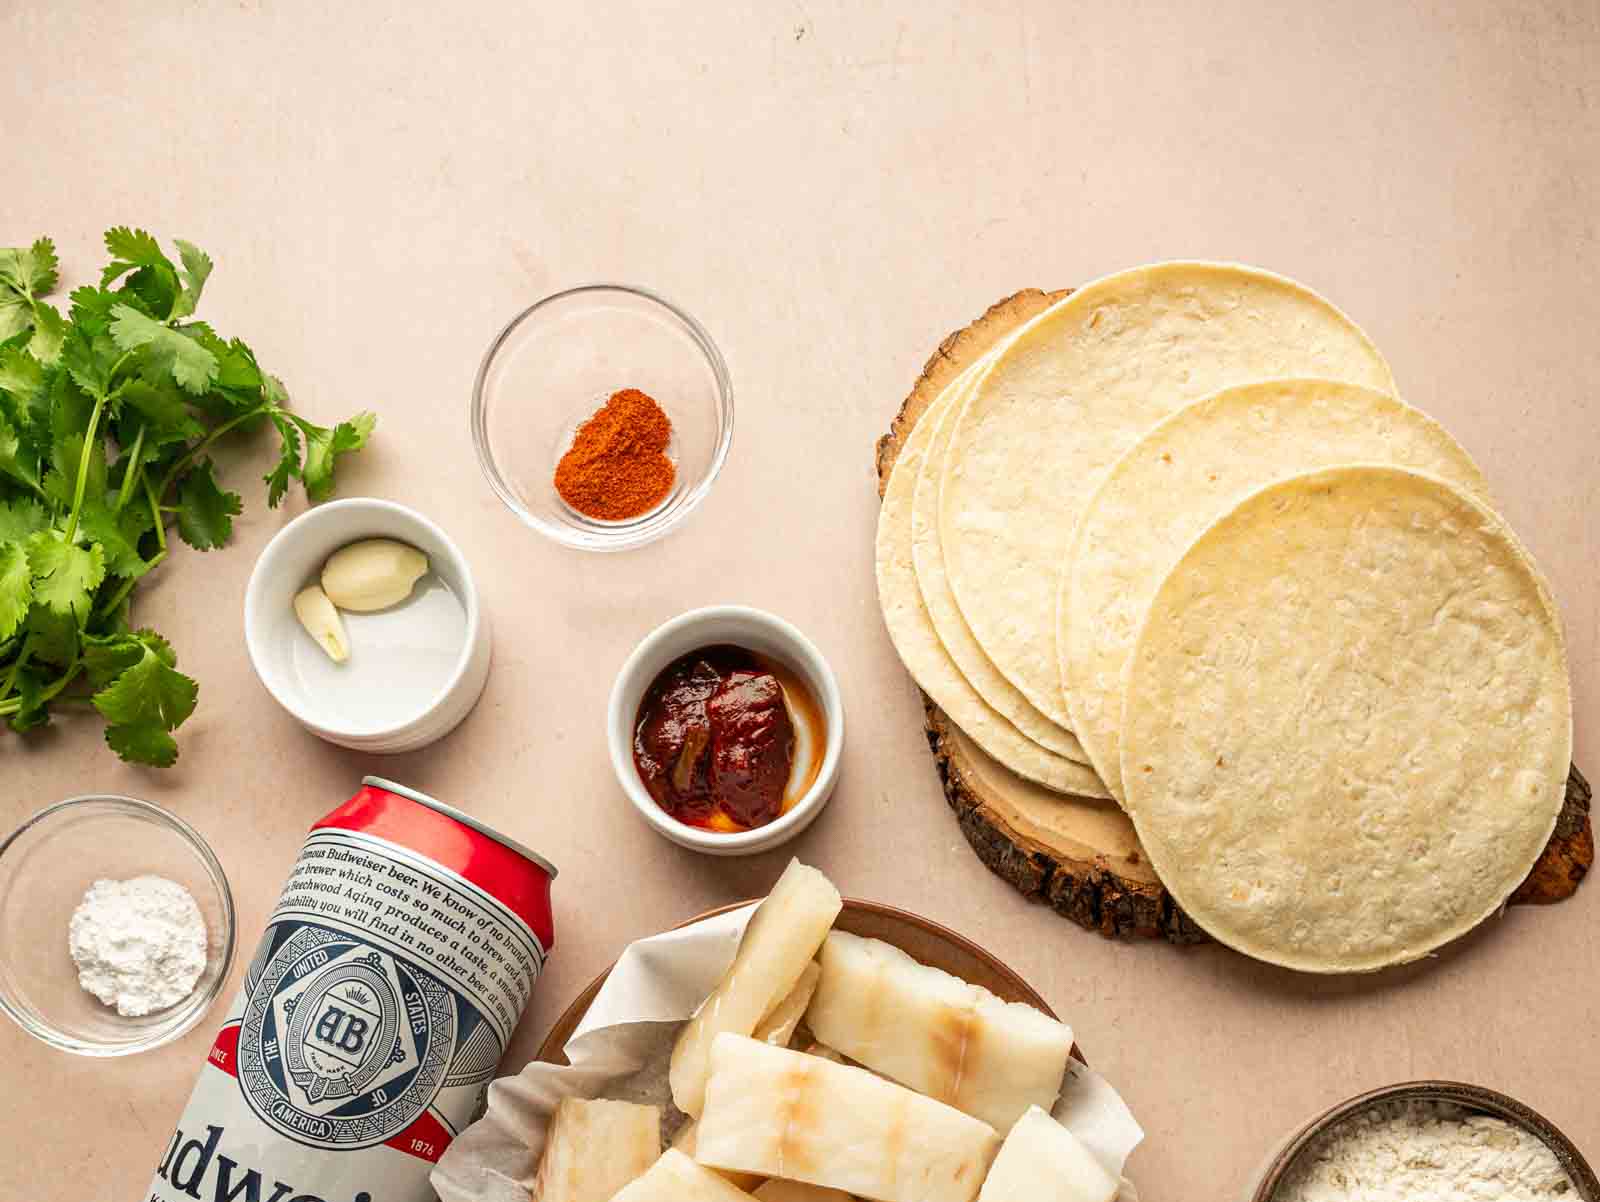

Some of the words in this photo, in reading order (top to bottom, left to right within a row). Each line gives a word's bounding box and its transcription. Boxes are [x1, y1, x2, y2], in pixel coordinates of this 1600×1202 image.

[305, 863, 336, 877] brewer
[338, 868, 372, 887] which
[376, 881, 410, 902] costs
[412, 899, 429, 912] so
[431, 908, 466, 935] much
[467, 930, 481, 944] to
[480, 940, 505, 964] brew
[504, 961, 520, 981] and
[327, 848, 387, 873] Budweiser
[387, 865, 418, 889] beer.
[421, 881, 441, 899] We
[442, 893, 478, 919] know
[476, 917, 494, 930] of
[489, 926, 504, 941] no
[503, 936, 527, 964] brand
[289, 878, 343, 895] Beechwood
[384, 904, 449, 943] produces
[450, 940, 460, 951] a
[460, 946, 489, 975] taste,
[489, 971, 497, 981] a
[292, 950, 329, 979] UNITED
[320, 900, 342, 913] you
[344, 907, 369, 923] will
[368, 916, 399, 937] find
[399, 930, 414, 945] in
[416, 940, 434, 956] no
[436, 951, 468, 977] other
[467, 972, 489, 993] beer
[487, 993, 499, 1005] at
[405, 992, 427, 1035] STATES
[263, 1037, 280, 1063] THE
[370, 1088, 388, 1108] OF
[274, 1104, 325, 1137] AMERICA
